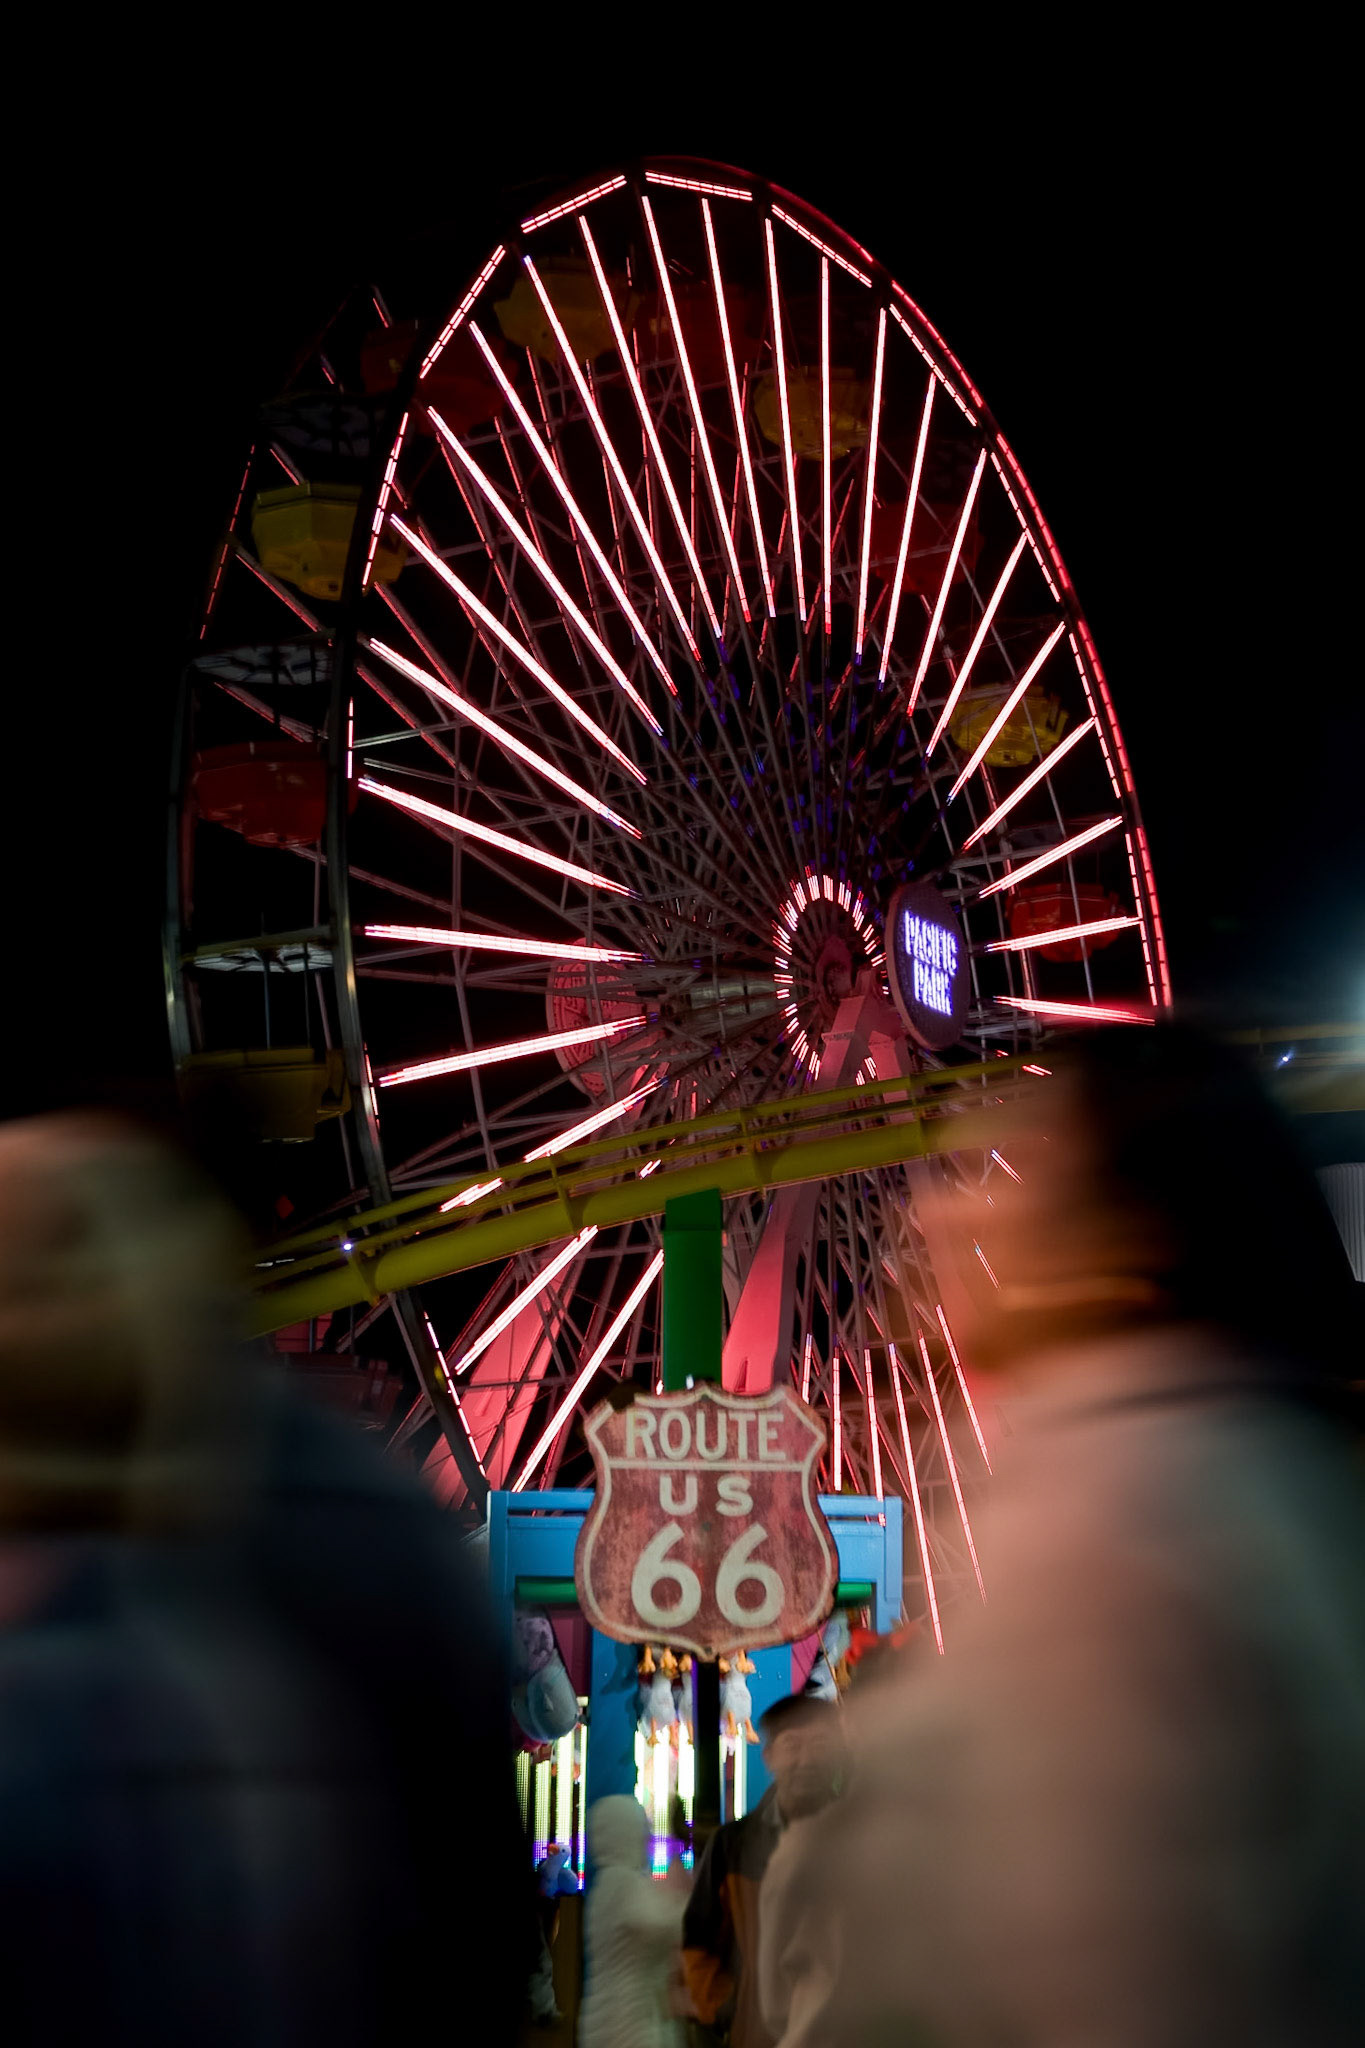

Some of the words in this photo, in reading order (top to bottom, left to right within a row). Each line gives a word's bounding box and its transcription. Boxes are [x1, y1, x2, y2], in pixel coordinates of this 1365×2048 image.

[904, 910, 957, 976] PACIFIC
[913, 957, 952, 1016] PARK
[625, 1408, 787, 1462] ROUTE
[659, 1473, 754, 1517] US
[630, 1521, 786, 1629] 66
